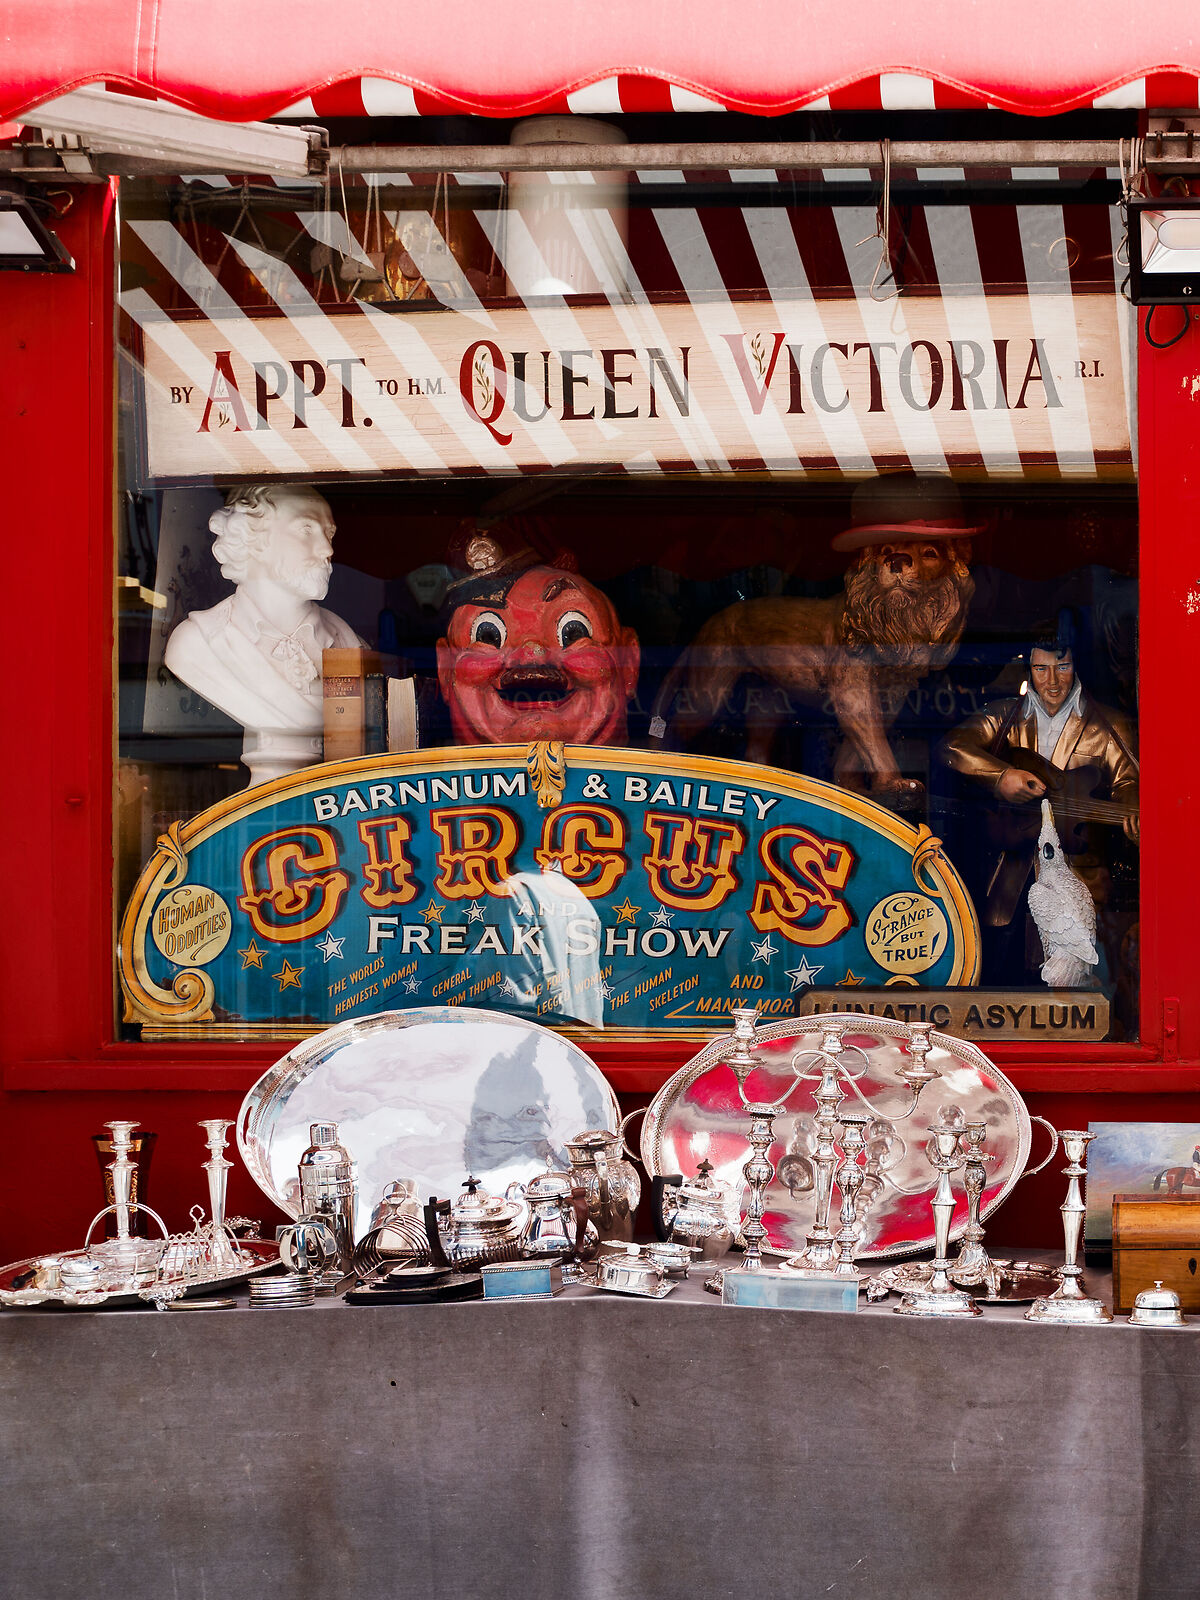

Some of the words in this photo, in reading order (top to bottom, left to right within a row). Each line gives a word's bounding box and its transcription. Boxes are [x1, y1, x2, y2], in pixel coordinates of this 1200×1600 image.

[170, 386, 194, 404] BY
[196, 351, 373, 433] APPT.
[375, 378, 399, 396] TO
[407, 377, 447, 396] H.M.
[459, 339, 692, 447] QUEEN
[719, 332, 1064, 416] VICTORIA
[1074, 359, 1105, 379] R.I.
[313, 772, 528, 822] BARNNUM
[582, 773, 610, 800] &
[623, 775, 778, 821] BAILEY
[236, 803, 855, 948] CIRCUS
[158, 893, 215, 935] HUMAN
[516, 902, 578, 917] AND
[871, 907, 934, 945] STRANGE
[165, 911, 227, 957] ODDITIES
[366, 914, 543, 956] FREAK
[564, 916, 731, 958] SHOW
[882, 931, 940, 962] TRUE!
[900, 931, 925, 943] BUT
[327, 977, 348, 998] THE
[335, 982, 379, 1016] HEAVIESTS
[382, 960, 418, 989] WOMAN
[432, 967, 473, 998] GENERAL
[446, 992, 467, 1007] TOM
[469, 970, 502, 997] THUMB
[546, 967, 571, 991] FOUR
[574, 964, 613, 995] WOMAN
[609, 990, 630, 1011] THE
[634, 967, 673, 999] HUMAN
[649, 974, 700, 1012] SKELETON
[730, 974, 764, 990] AND
[755, 998, 796, 1014] MOR
[962, 1004, 1096, 1030] ASYLUM
